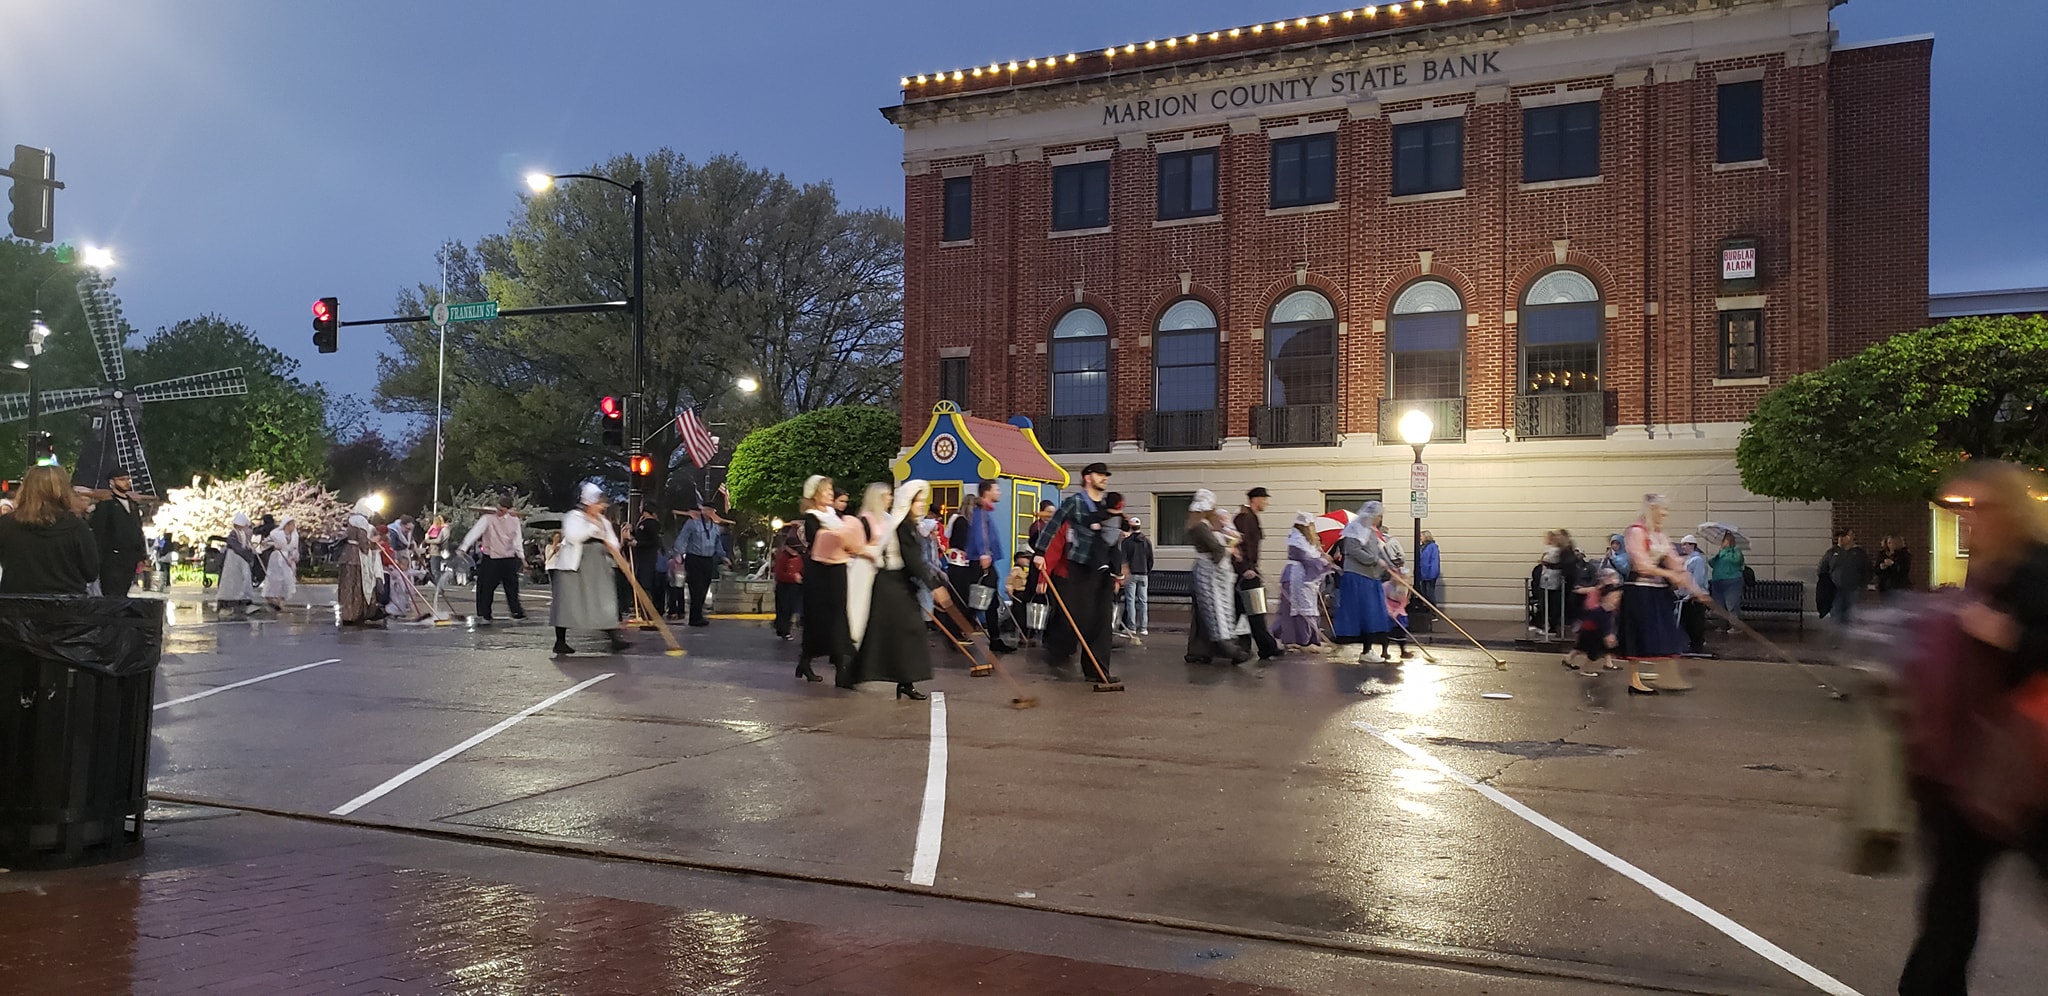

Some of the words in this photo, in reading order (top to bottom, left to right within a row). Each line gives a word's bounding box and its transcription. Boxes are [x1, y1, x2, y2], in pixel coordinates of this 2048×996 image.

[1103, 93, 1198, 126] MARION
[1211, 76, 1318, 110] COUNTY
[1331, 64, 1407, 94] STATE
[1423, 51, 1501, 82] BANK
[1724, 250, 1754, 260] BURGLAR
[1726, 261, 1752, 271] ALARM
[450, 304, 484, 320] FRANKLIN
